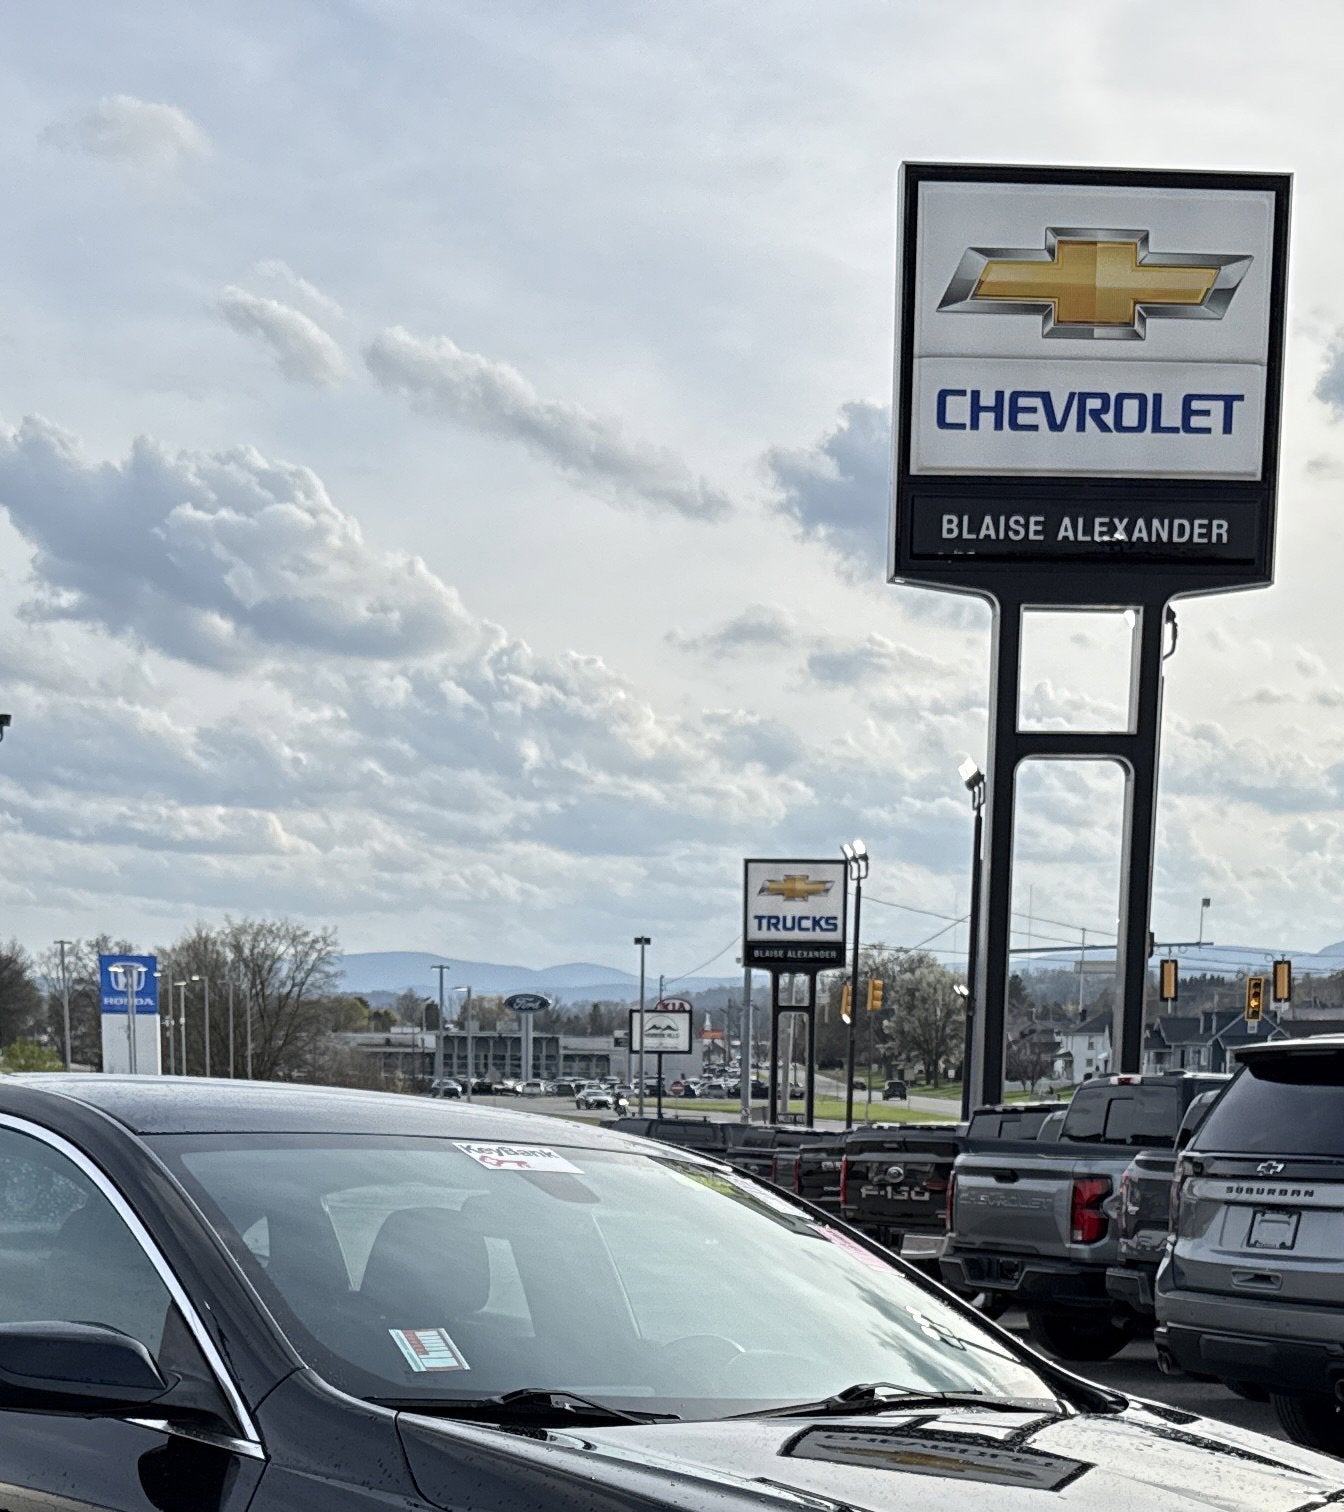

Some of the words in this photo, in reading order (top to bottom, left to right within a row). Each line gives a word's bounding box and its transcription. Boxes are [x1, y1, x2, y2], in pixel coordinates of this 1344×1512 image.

[936, 388, 1245, 436] CHEVROLET
[941, 513, 1046, 543] BLAISE
[1056, 515, 1229, 545] ALEXANDER
[753, 915, 838, 932] TRUCKS
[753, 949, 783, 958] BLAISE
[786, 950, 837, 959] ALEXANDER
[103, 997, 155, 1006] HODA
[513, 997, 542, 1010] Ford
[659, 1002, 687, 1011] KIA
[458, 1144, 560, 1159] KeyBank
[1225, 1186, 1315, 1198] SUBURBAN
